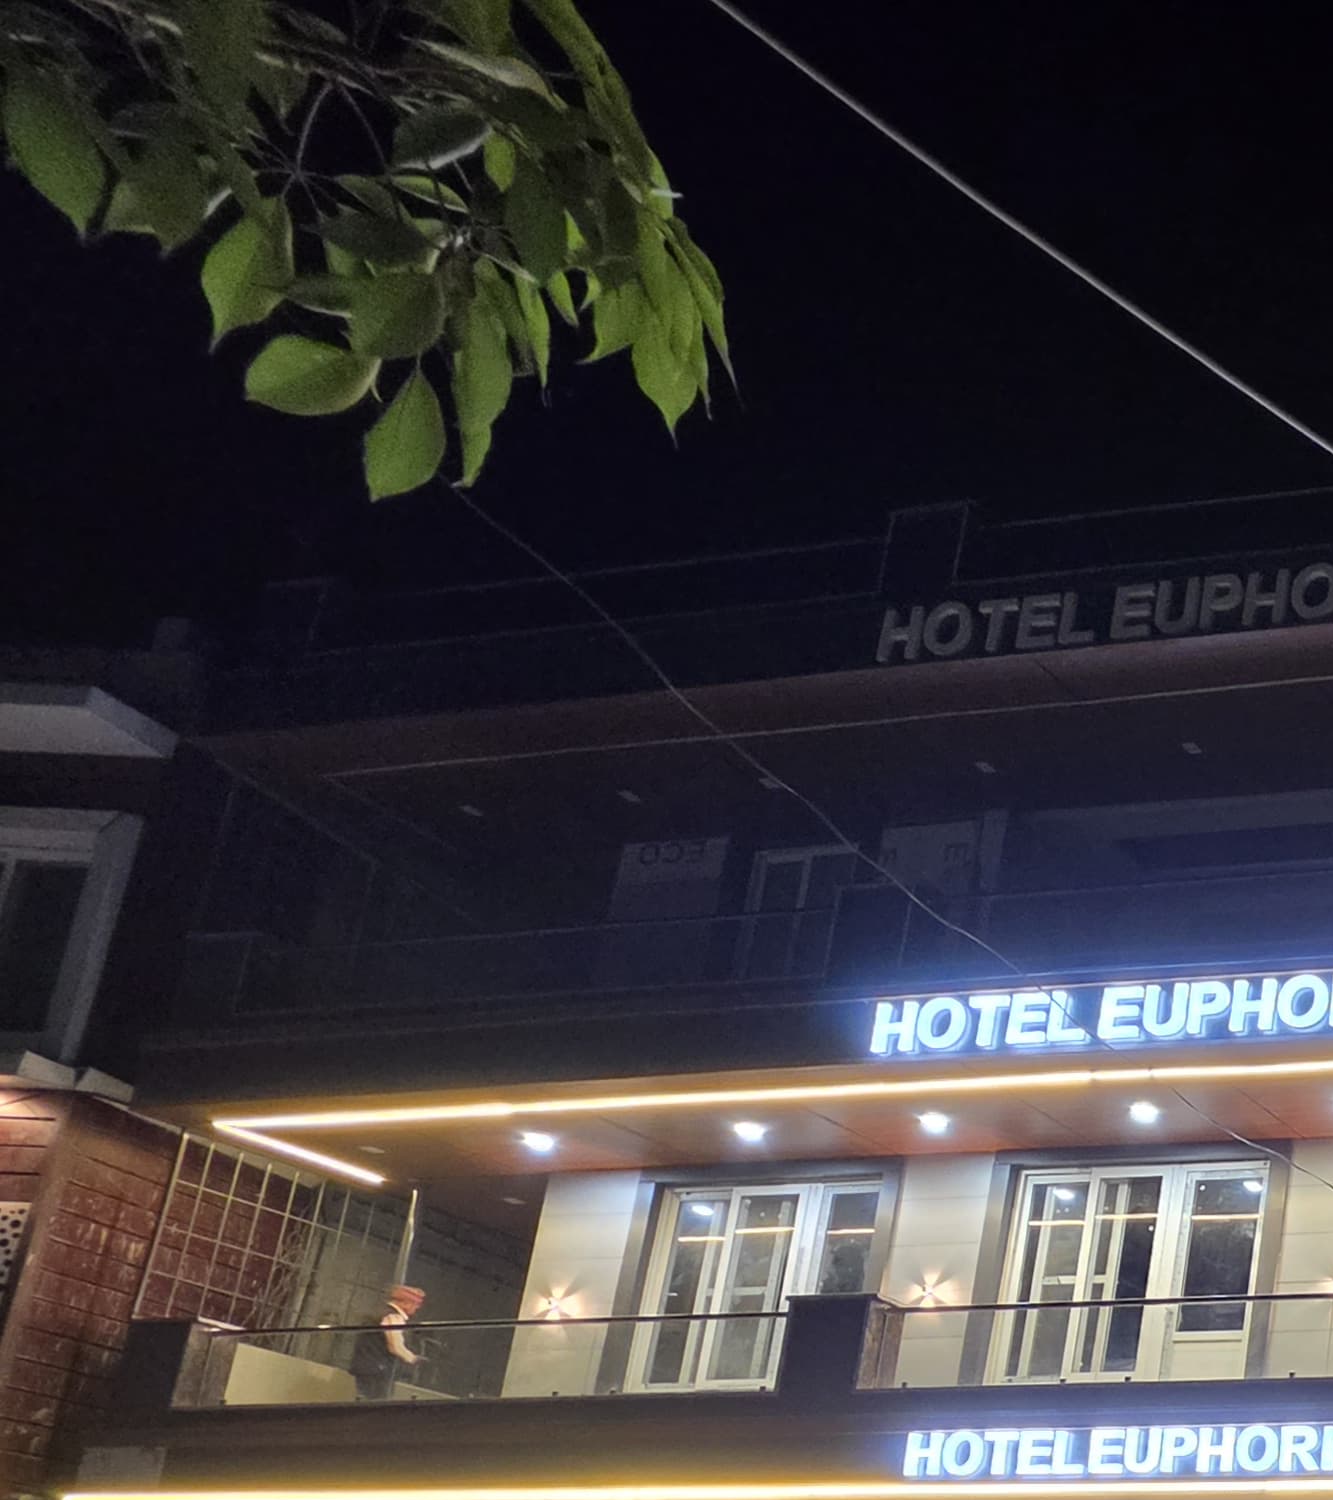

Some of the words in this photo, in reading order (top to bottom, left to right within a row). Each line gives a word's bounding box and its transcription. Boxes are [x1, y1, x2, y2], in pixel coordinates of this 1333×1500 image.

[875, 592, 1094, 663] HOTEL
[868, 990, 1091, 1056] HOTEL
[902, 1429, 1090, 1478] HOTEL
